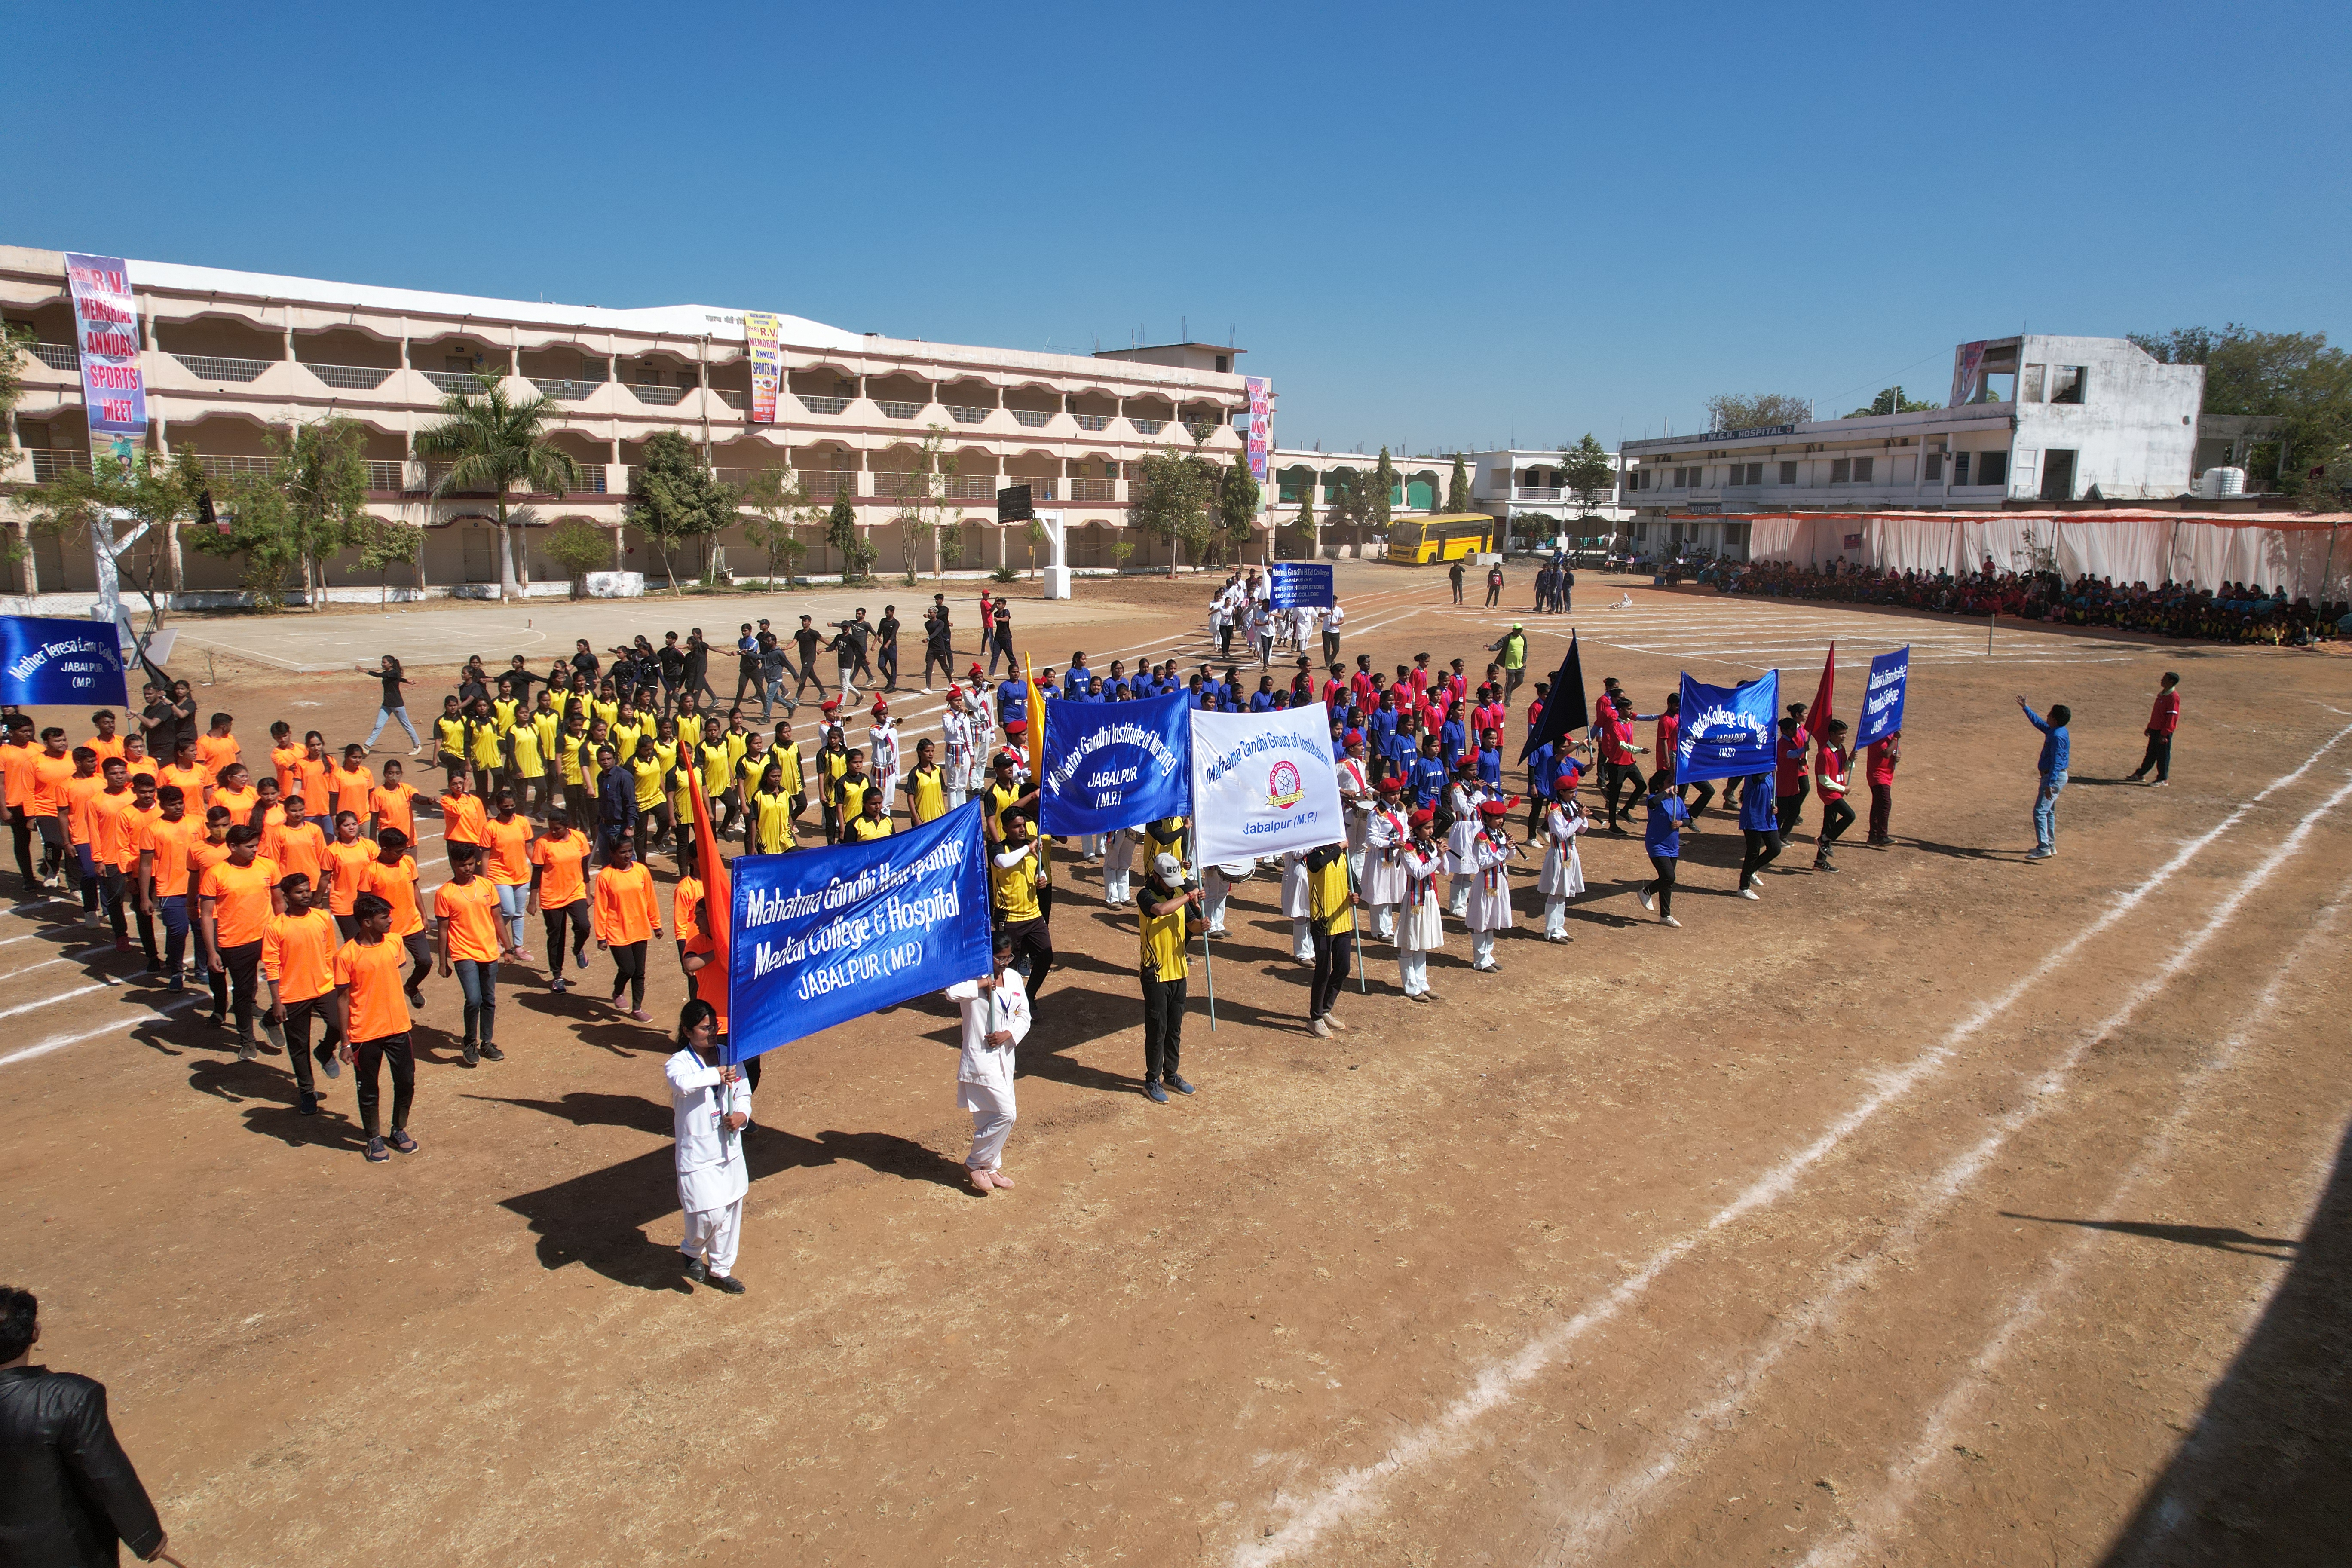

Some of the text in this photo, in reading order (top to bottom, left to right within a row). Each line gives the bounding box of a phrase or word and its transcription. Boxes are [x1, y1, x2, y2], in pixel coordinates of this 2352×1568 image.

[70, 266, 127, 294] SHRI R.V.
[80, 297, 132, 323] MEMORIAL
[87, 331, 133, 356] ANNUAL
[756, 350, 776, 360] ANNUAL
[90, 365, 138, 390] SPORTS
[753, 362, 770, 375] SPORTS
[103, 398, 132, 422] MEET
[1252, 401, 1268, 415] MEMORIAL
[1251, 420, 1265, 434] ANNUAL
[1708, 427, 1783, 441] M.G.H. HOSPITAL
[1250, 439, 1265, 453] SPORTS
[1252, 459, 1262, 472] MEET
[8, 636, 120, 682] Mother Teresa Law College
[61, 662, 104, 673] JABALPUR
[1707, 704, 1736, 729] College
[1737, 710, 1749, 728] of
[1080, 725, 1110, 755] Gandhi
[1112, 722, 1145, 747] Institute
[1142, 730, 1155, 749] of
[1709, 733, 1746, 743] JABALPUR
[1148, 730, 1177, 777] Nursing
[1206, 732, 1331, 786] Mahatma Gandhi Group of Institution
[1088, 766, 1137, 788] JABALPUR
[1289, 765, 1299, 787] HUMANITY
[1096, 790, 1122, 810] (M.P.)
[1243, 812, 1318, 834] Jabalpur (M.P.)
[1167, 865, 1179, 873] BOY
[746, 888, 823, 928] Mahatma
[824, 868, 876, 910] Gandhi
[754, 933, 813, 980] Medical
[808, 916, 870, 956] College
[888, 880, 960, 933] Hospital
[799, 953, 880, 1001] JABALPUR
